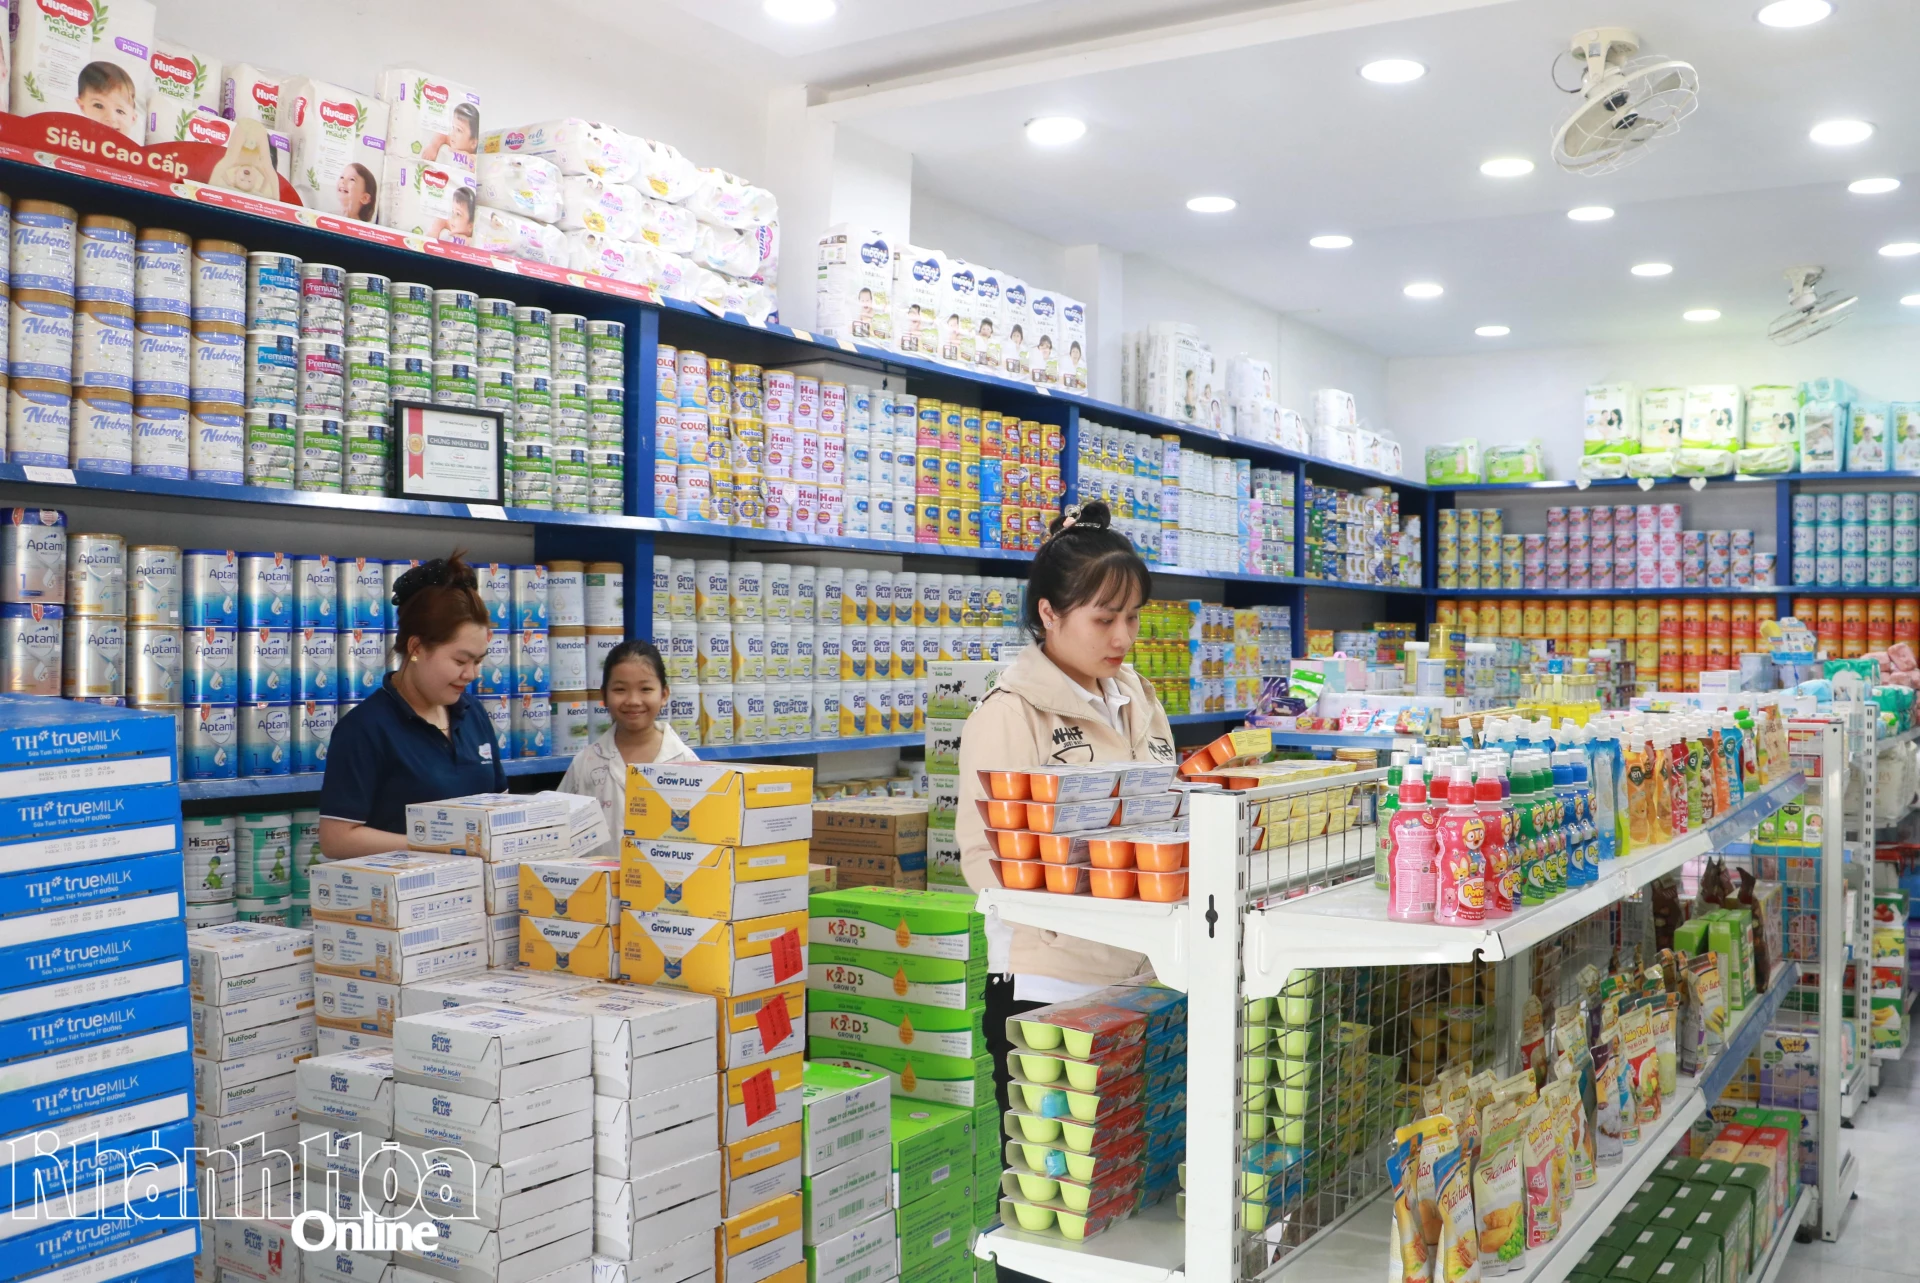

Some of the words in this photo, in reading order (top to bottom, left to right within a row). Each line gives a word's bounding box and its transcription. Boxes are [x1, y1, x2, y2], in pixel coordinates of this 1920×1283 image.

[44, 14, 87, 35] nature
[122, 43, 144, 57] pants
[154, 59, 193, 80] HUGGIES
[155, 76, 190, 93] nature
[323, 106, 355, 124] HUGGIES
[193, 123, 226, 141] HUGGIES
[323, 121, 351, 135] nature
[46, 126, 96, 155] Siêu
[101, 141, 143, 165] Cao
[147, 151, 189, 178] Cấp
[453, 152, 469, 165] XXL
[14, 228, 70, 250] Nubone
[135, 255, 181, 272] Nubone
[305, 283, 337, 294] Premium
[391, 373, 419, 384] Premium
[800, 394, 812, 402] Kid
[823, 399, 836, 407] Kid
[251, 429, 284, 440] Premium
[305, 435, 336, 445] Premium
[352, 440, 382, 450] Premium
[27, 539, 64, 552] Aptami
[78, 553, 120, 565] Aptamil
[136, 565, 176, 576] Aptamil
[209, 568, 237, 580] Aptam
[547, 576, 577, 585] ndamil
[523, 609, 533, 622] 2
[17, 632, 59, 645] Aptamil
[195, 645, 233, 656] Aptamil
[254, 645, 288, 656] Aptamil
[670, 700, 693, 708] Grow
[200, 721, 235, 733] Aptamil
[18, 806, 42, 822] TH
[188, 837, 199, 847] Hi
[543, 874, 560, 884] Grow
[25, 882, 51, 899] TH
[318, 889, 330, 898] FDI
[249, 914, 260, 924] Hi
[543, 928, 560, 937] Grow
[651, 923, 672, 933] Grow
[835, 936, 848, 944] GROW
[322, 944, 334, 952] FDI
[25, 953, 52, 971] TH
[227, 977, 256, 988] Nutifood
[833, 983, 848, 991] GROW
[323, 996, 335, 1004] FDI
[28, 1023, 54, 1042] TH
[838, 1031, 853, 1039] GROW
[228, 1033, 257, 1044] Nutifood
[431, 1034, 451, 1045] Grow
[330, 1074, 348, 1085] Grow
[227, 1086, 256, 1099] Nutifood
[32, 1094, 58, 1112] TH
[432, 1097, 451, 1108] Grow
[244, 1228, 262, 1242] Grow
